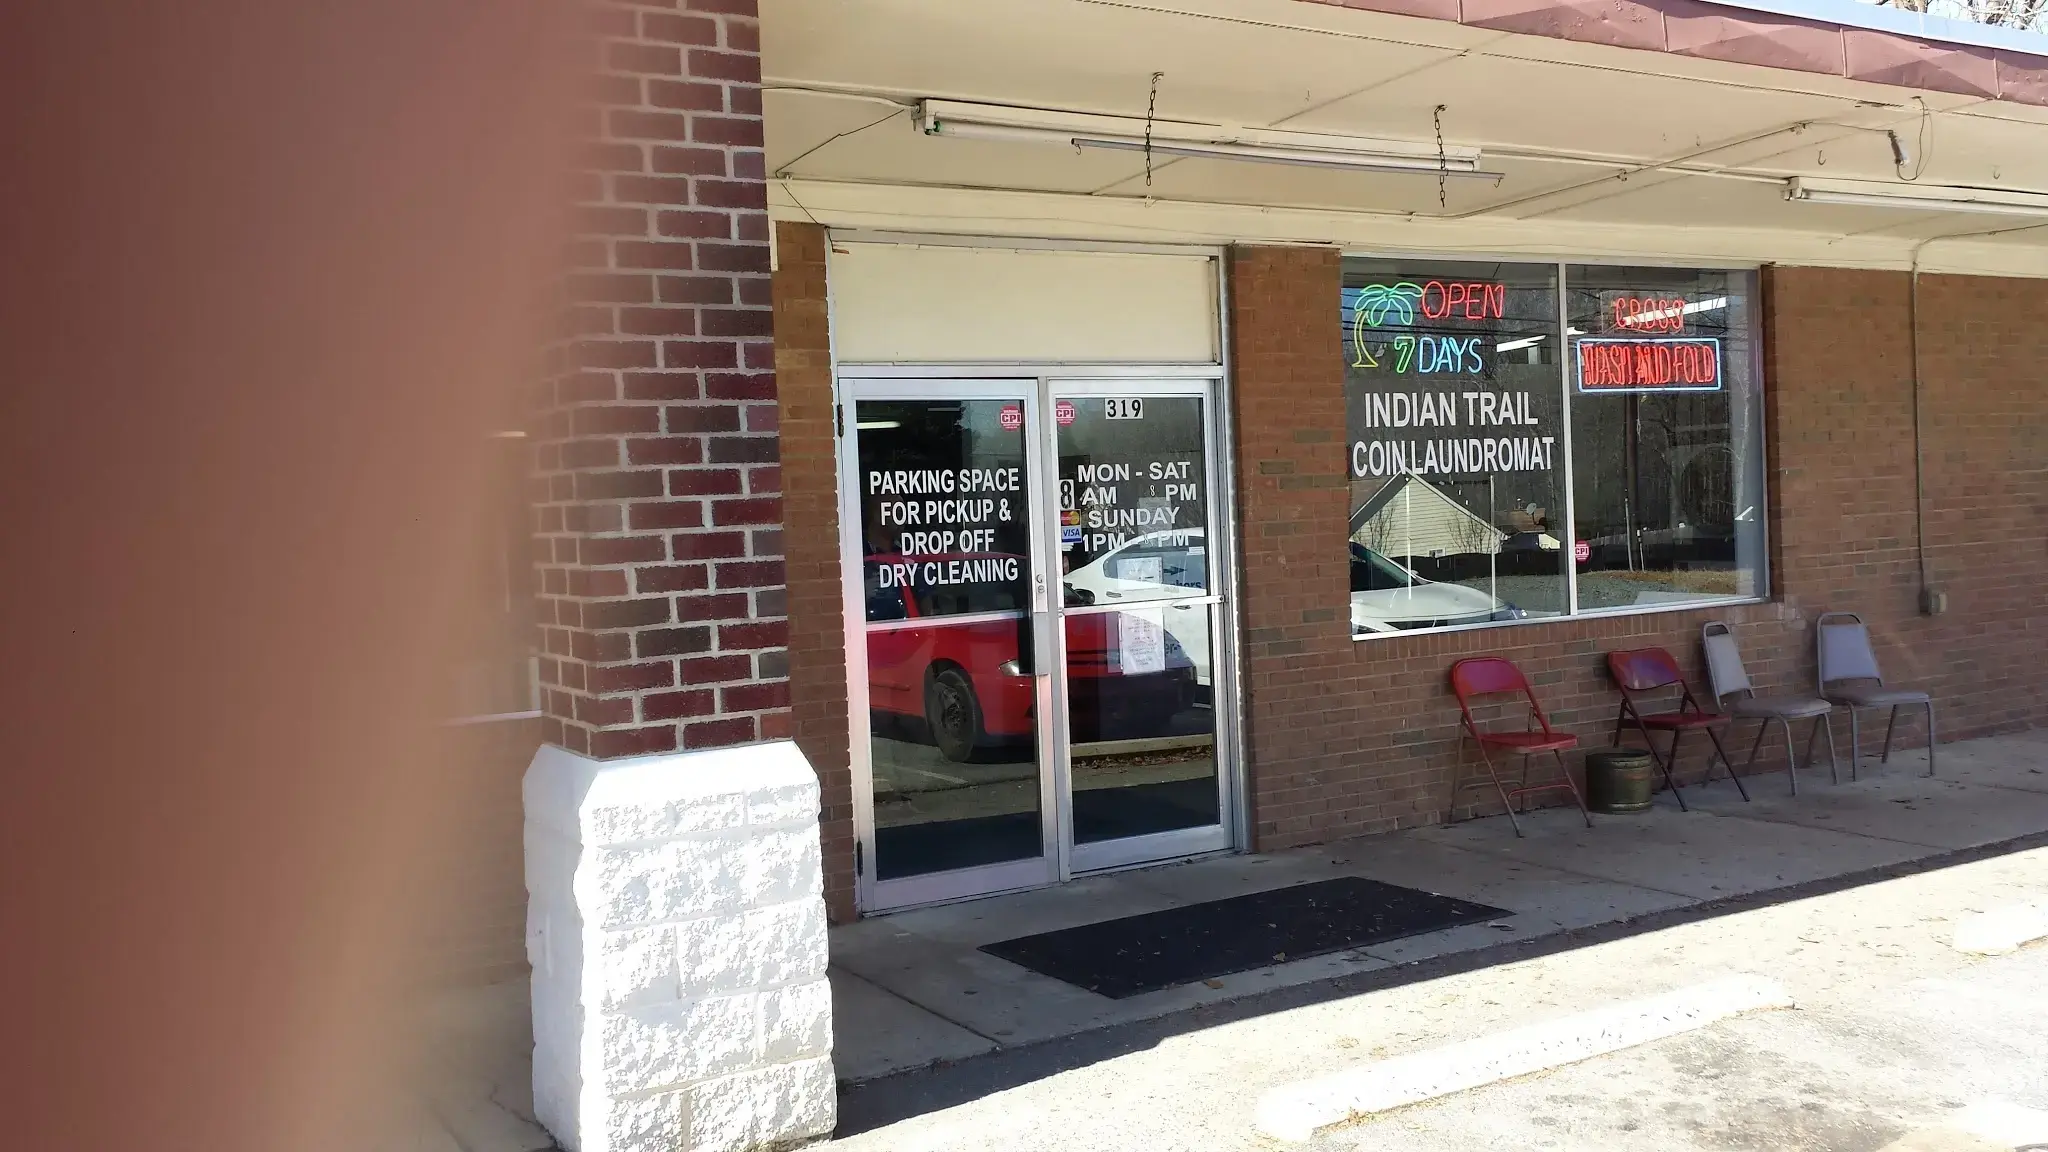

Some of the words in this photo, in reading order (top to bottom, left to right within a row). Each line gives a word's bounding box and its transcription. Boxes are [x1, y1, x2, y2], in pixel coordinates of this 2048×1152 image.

[1421, 280, 1504, 319] OPEN
[1615, 297, 1685, 330] CROSS
[1394, 336, 1416, 374] 7
[1418, 337, 1483, 374] DAYS
[1635, 344, 1671, 385] AND
[1673, 344, 1715, 384] FOLD
[1001, 414, 1021, 422] CPI
[1056, 409, 1074, 417] CPI
[1107, 399, 1142, 418] 319
[1364, 392, 1456, 428] INDIAN
[1462, 391, 1539, 426] TRAIL
[1352, 440, 1407, 478] COIN
[1410, 436, 1554, 476] LAUNDROMAT
[869, 469, 955, 495] PARKING
[959, 467, 1020, 493] SPACE
[1077, 463, 1130, 483] MON
[1149, 461, 1191, 480] SAT
[1060, 480, 1072, 509] 8
[1081, 486, 1117, 506] AM
[1165, 483, 1197, 501] PM
[880, 501, 921, 526] FOR
[925, 498, 993, 524] PICKUP
[999, 498, 1012, 522] &
[1088, 506, 1180, 529] SUNDAY
[901, 530, 954, 556] DROP
[959, 528, 995, 553] OFF
[1063, 529, 1080, 537] VISA
[1157, 530, 1189, 548] PM
[1575, 547, 1588, 555] CPI
[879, 562, 919, 588] DRY
[924, 557, 1018, 586] CLEANING
